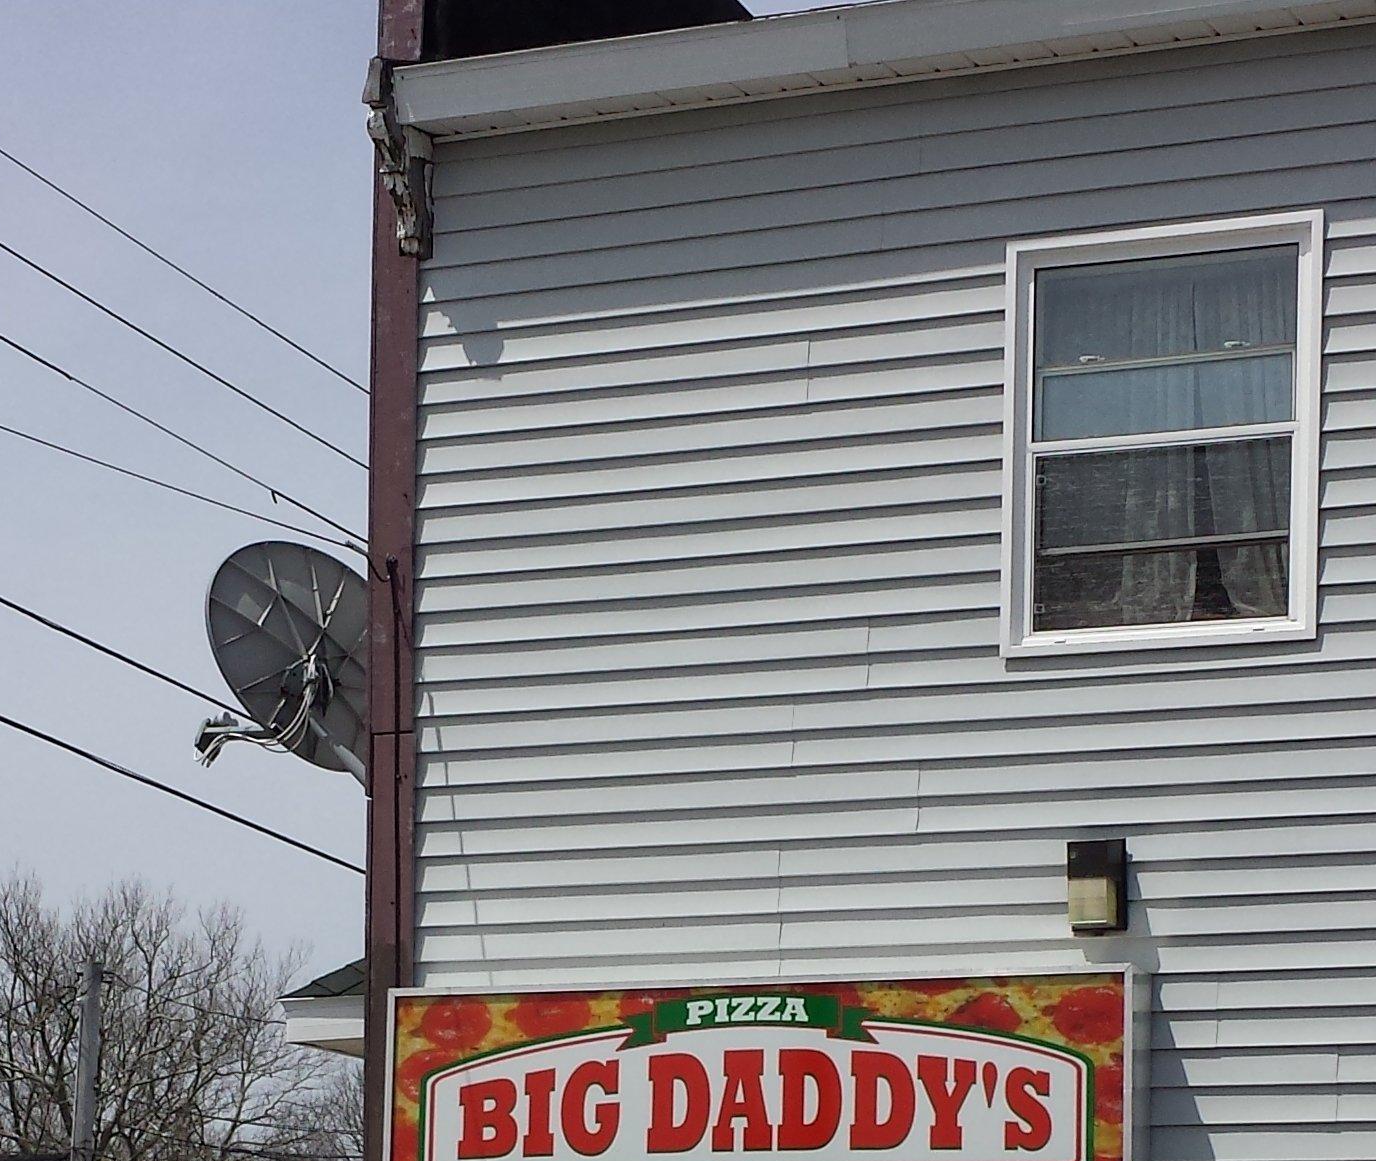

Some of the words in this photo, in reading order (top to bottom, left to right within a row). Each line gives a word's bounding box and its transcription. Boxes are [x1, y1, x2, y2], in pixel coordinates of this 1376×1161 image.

[685, 996, 809, 1026] PIZZA
[457, 1059, 620, 1160] BIG
[646, 1048, 1053, 1152] DADDY'S
